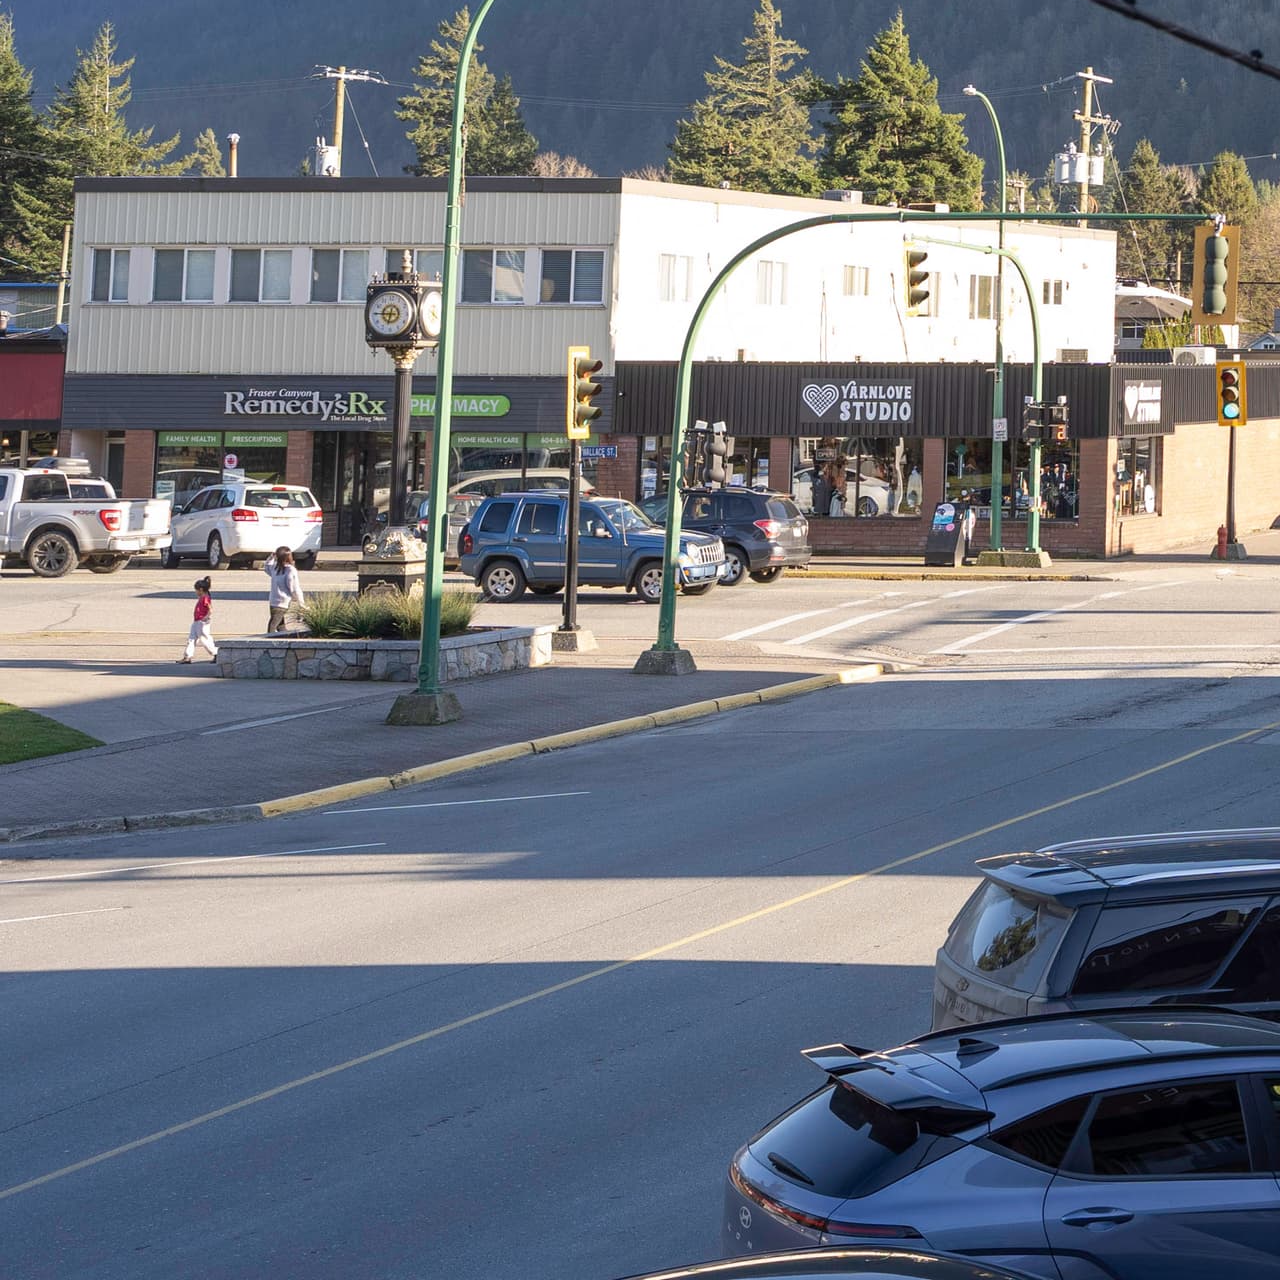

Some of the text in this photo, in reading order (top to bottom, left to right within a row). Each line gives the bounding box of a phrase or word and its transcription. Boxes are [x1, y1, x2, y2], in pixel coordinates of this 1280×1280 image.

[248, 388, 312, 399] Fraser Canyon
[841, 380, 912, 399] YARNLOVE
[411, 399, 499, 412] PHMACY
[840, 401, 912, 421] STUDIO
[232, 435, 282, 443] PRESCRIPTIONS
[502, 436, 518, 444] CARE
[582, 447, 615, 457] WALLACE ST.
